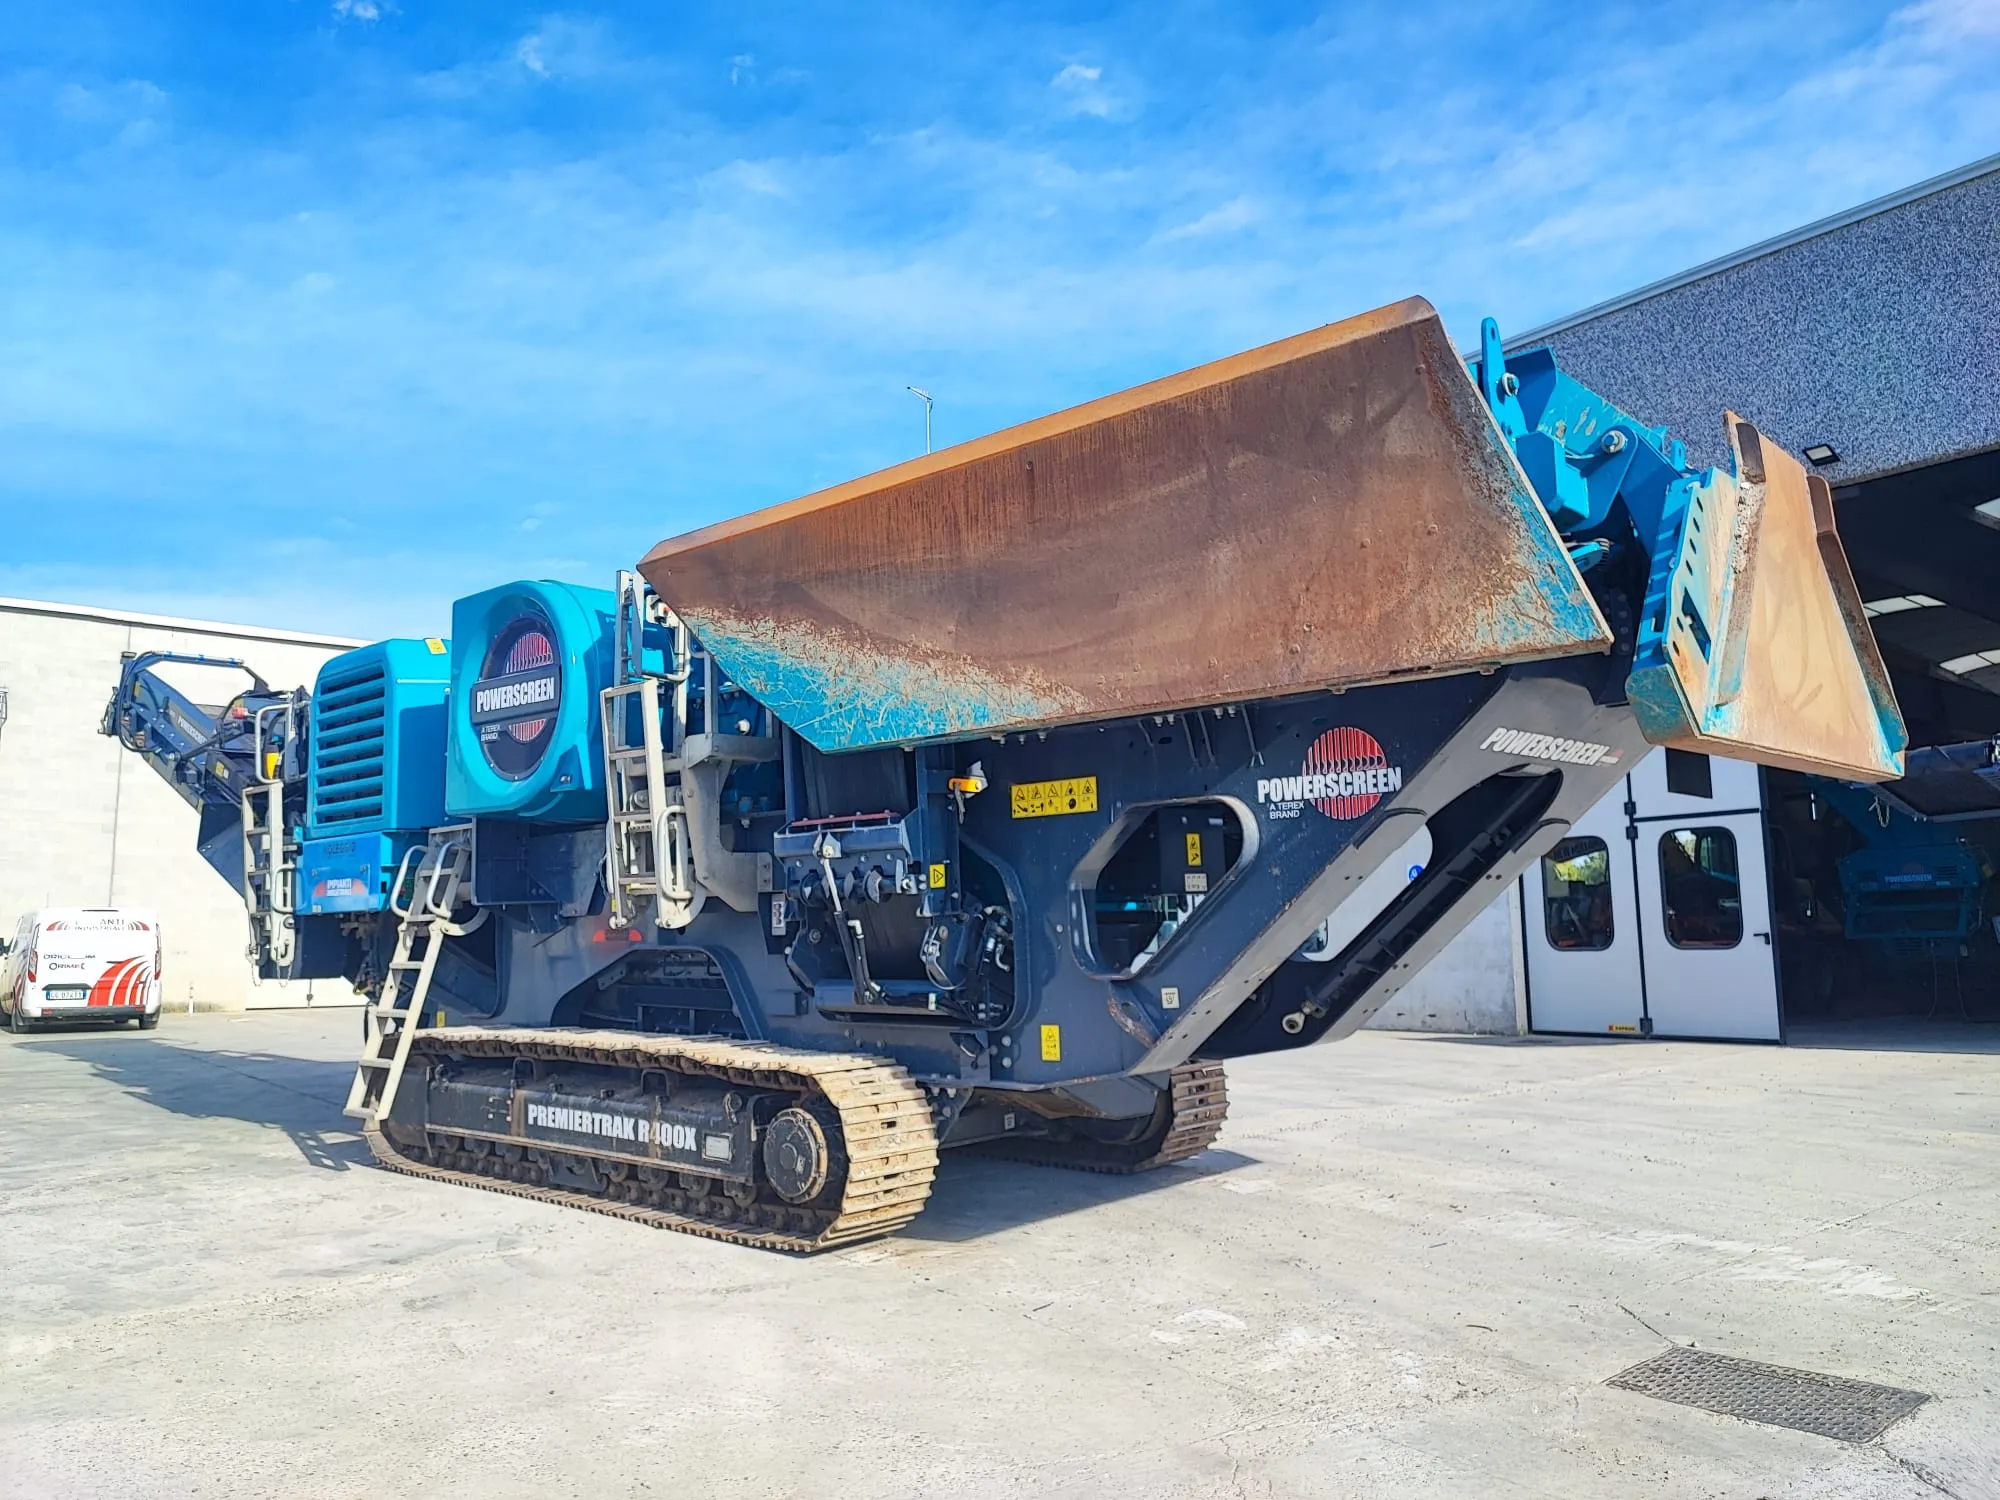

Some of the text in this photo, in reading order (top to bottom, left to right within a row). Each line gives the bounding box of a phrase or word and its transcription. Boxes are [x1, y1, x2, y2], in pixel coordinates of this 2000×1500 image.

[477, 677, 555, 713] POWERSCREEN
[1480, 727, 1610, 766] POWERSCREEN
[1256, 766, 1402, 803] POWERSCREEN
[1270, 800, 1305, 811] A TEREX
[1270, 810, 1300, 819] BRAND
[527, 1103, 636, 1141] PREMIERTRAK
[637, 1120, 698, 1152] R400X
